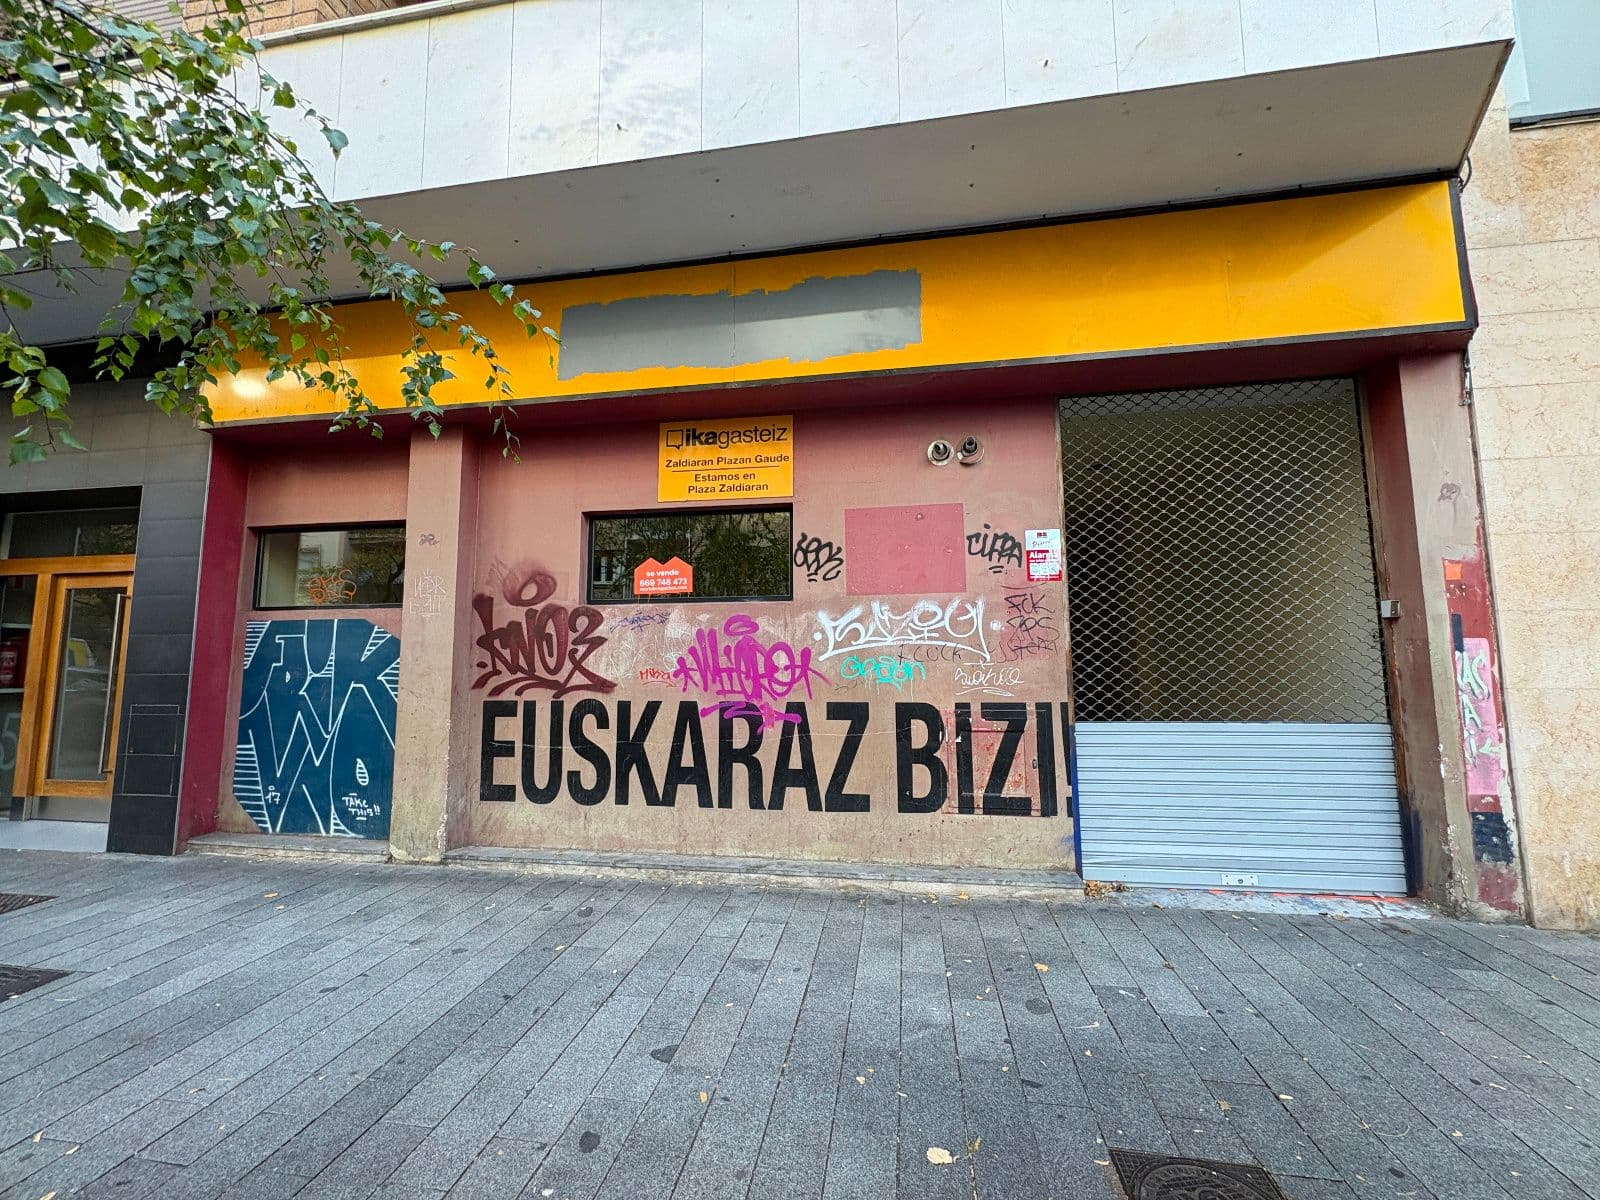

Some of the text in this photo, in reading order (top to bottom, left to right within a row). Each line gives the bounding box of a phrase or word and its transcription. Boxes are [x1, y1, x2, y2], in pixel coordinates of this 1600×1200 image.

[686, 424, 788, 449] ikagasteiz
[665, 453, 790, 468] Zaldiaran Plazan Gaude
[694, 472, 740, 482] Estamos
[688, 483, 769, 494] Plaza Zaldiaran
[656, 568, 680, 577] vende
[480, 699, 870, 812] EUSKARAZ
